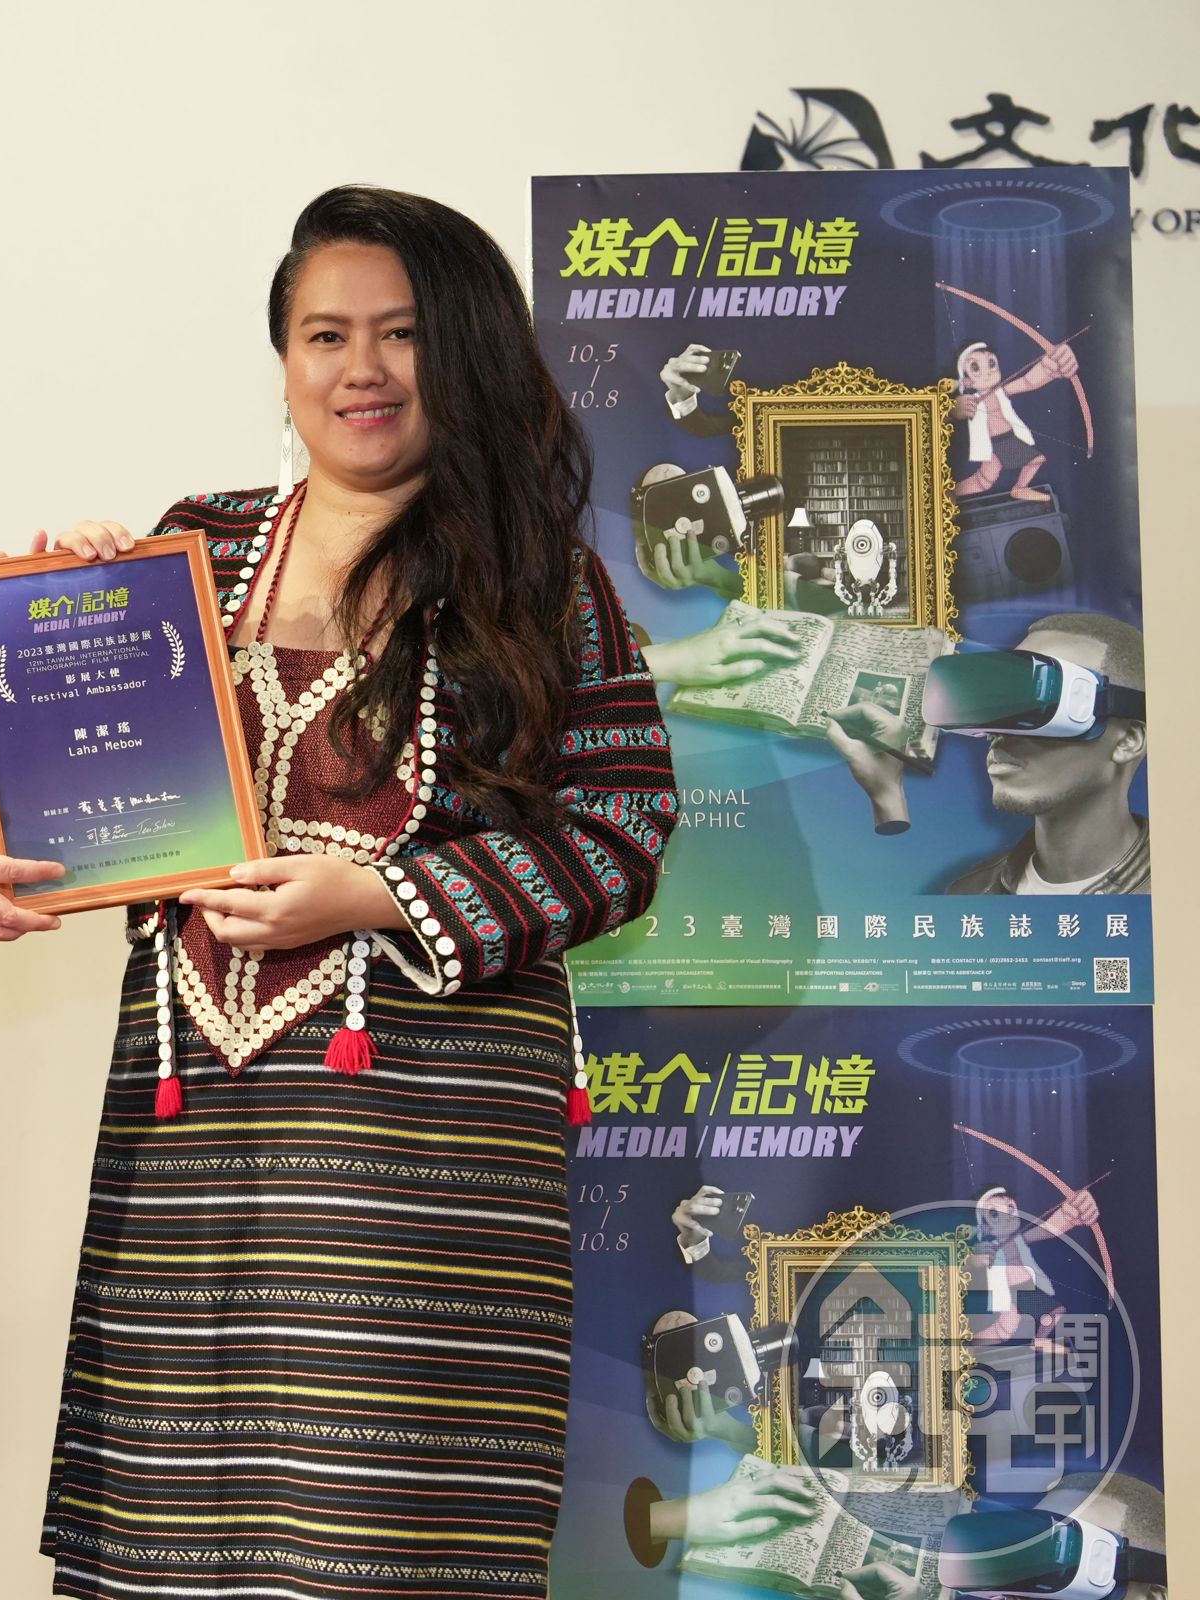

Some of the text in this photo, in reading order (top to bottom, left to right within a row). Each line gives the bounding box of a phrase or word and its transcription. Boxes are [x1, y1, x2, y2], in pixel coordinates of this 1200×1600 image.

[566, 287, 675, 319] MEDIA
[698, 286, 847, 318] MEMORY
[567, 343, 619, 362] 10.5
[569, 389, 619, 409] 10.8
[33, 618, 70, 634] MEDIA
[78, 610, 127, 627] MEMORY
[26, 651, 150, 674] ETHNOGRAPHIC FILM FESTIVAL
[29, 646, 140, 667] 12th TAIWAN INTERNATIONAL
[31, 679, 147, 703] Festival Ambassador
[68, 738, 143, 757] Laha Mebow
[576, 1127, 687, 1158] MEDIA
[711, 1126, 864, 1158] MEMORY
[577, 1184, 630, 1203] 10.5
[578, 1232, 629, 1251] 10.8
